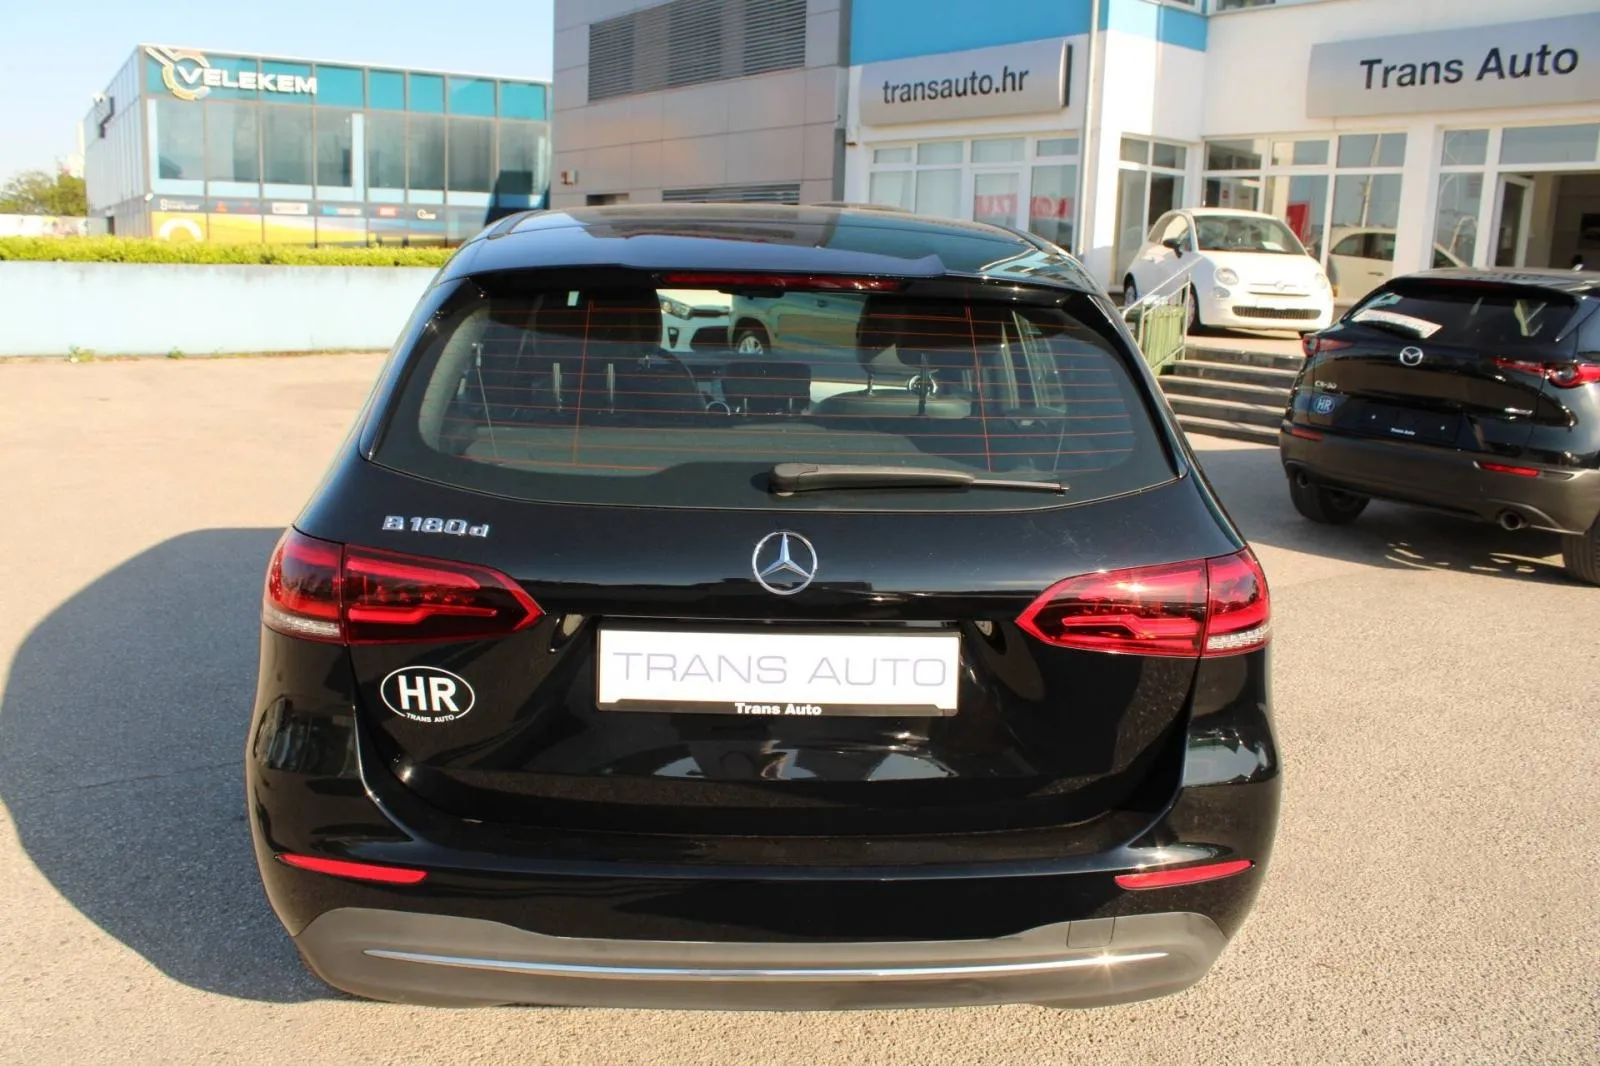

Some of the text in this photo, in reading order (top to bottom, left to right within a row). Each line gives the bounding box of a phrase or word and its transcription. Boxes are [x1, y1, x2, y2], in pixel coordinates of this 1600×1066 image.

[176, 65, 317, 95] VELEKEM
[1359, 44, 1579, 89] Trans Auto
[882, 65, 1030, 104] transauto.hr
[1316, 398, 1332, 411] HR
[382, 515, 405, 531] B
[612, 651, 947, 687] TRANS AUTO
[397, 674, 460, 712] HR
[405, 712, 455, 723] TRANS AUTO
[734, 702, 822, 716] Trans Auto
